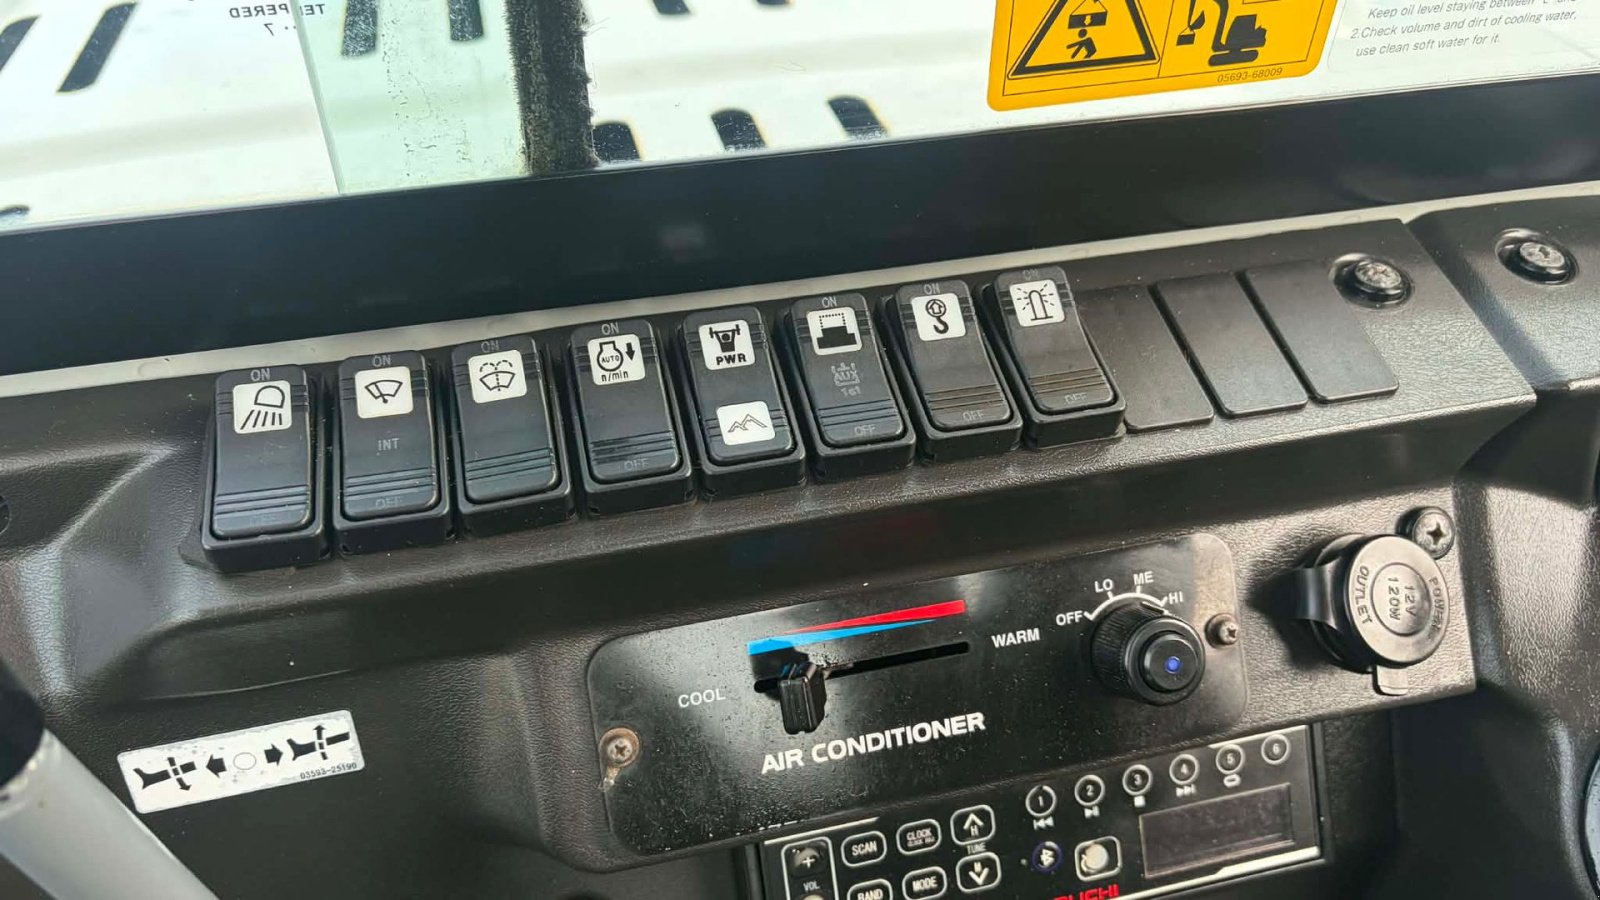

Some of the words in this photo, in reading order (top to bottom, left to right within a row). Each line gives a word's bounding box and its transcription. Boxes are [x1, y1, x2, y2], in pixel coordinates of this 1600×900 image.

[1368, 8, 1398, 19] Keep
[1401, 4, 1415, 16] oil
[1417, 2, 1444, 15] level
[1446, 0, 1487, 13] staying
[1350, 25, 1398, 39] 2.Check
[1401, 22, 1441, 34] volume
[1443, 19, 1466, 31] and
[1468, 16, 1488, 28] dirt
[1490, 15, 1503, 26] of
[1504, 13, 1543, 25] cooling
[1545, 10, 1577, 21] water,
[1356, 46, 1376, 57] use
[1379, 42, 1410, 55] clean
[1413, 39, 1435, 51] soft
[1438, 37, 1469, 48] water
[1472, 34, 1488, 45] for
[1217, 67, 1283, 84] 05693-68009
[1022, 268, 1039, 280] ON
[924, 283, 940, 295] ON
[821, 296, 838, 308] ON
[601, 322, 620, 335] ON
[481, 340, 499, 353] ON
[372, 355, 392, 367] ON
[601, 355, 620, 364] AUTO
[716, 353, 747, 366] PWR
[251, 368, 271, 381] ON
[601, 371, 629, 382] n/min
[1065, 392, 1088, 404] OFF
[963, 409, 985, 421] OFF
[854, 423, 877, 437] OFF
[377, 438, 400, 452] INT
[624, 458, 650, 471] OFF
[1133, 571, 1154, 585] ME
[1094, 578, 1114, 592] LO
[1168, 591, 1184, 604] HI
[1352, 565, 1373, 625] OUTLET
[1387, 577, 1402, 621] 120W
[1404, 585, 1417, 618] 12V
[1056, 610, 1083, 626] OFF
[991, 627, 1041, 649] WARM
[678, 687, 727, 709] COOL
[761, 749, 805, 775] AIR
[811, 711, 986, 763] CONDITIONER
[851, 841, 878, 856] SCAN
[967, 842, 986, 855] TUNE
[803, 881, 820, 892] VOL
[912, 876, 938, 892] MODE
[857, 888, 884, 900] BAND
